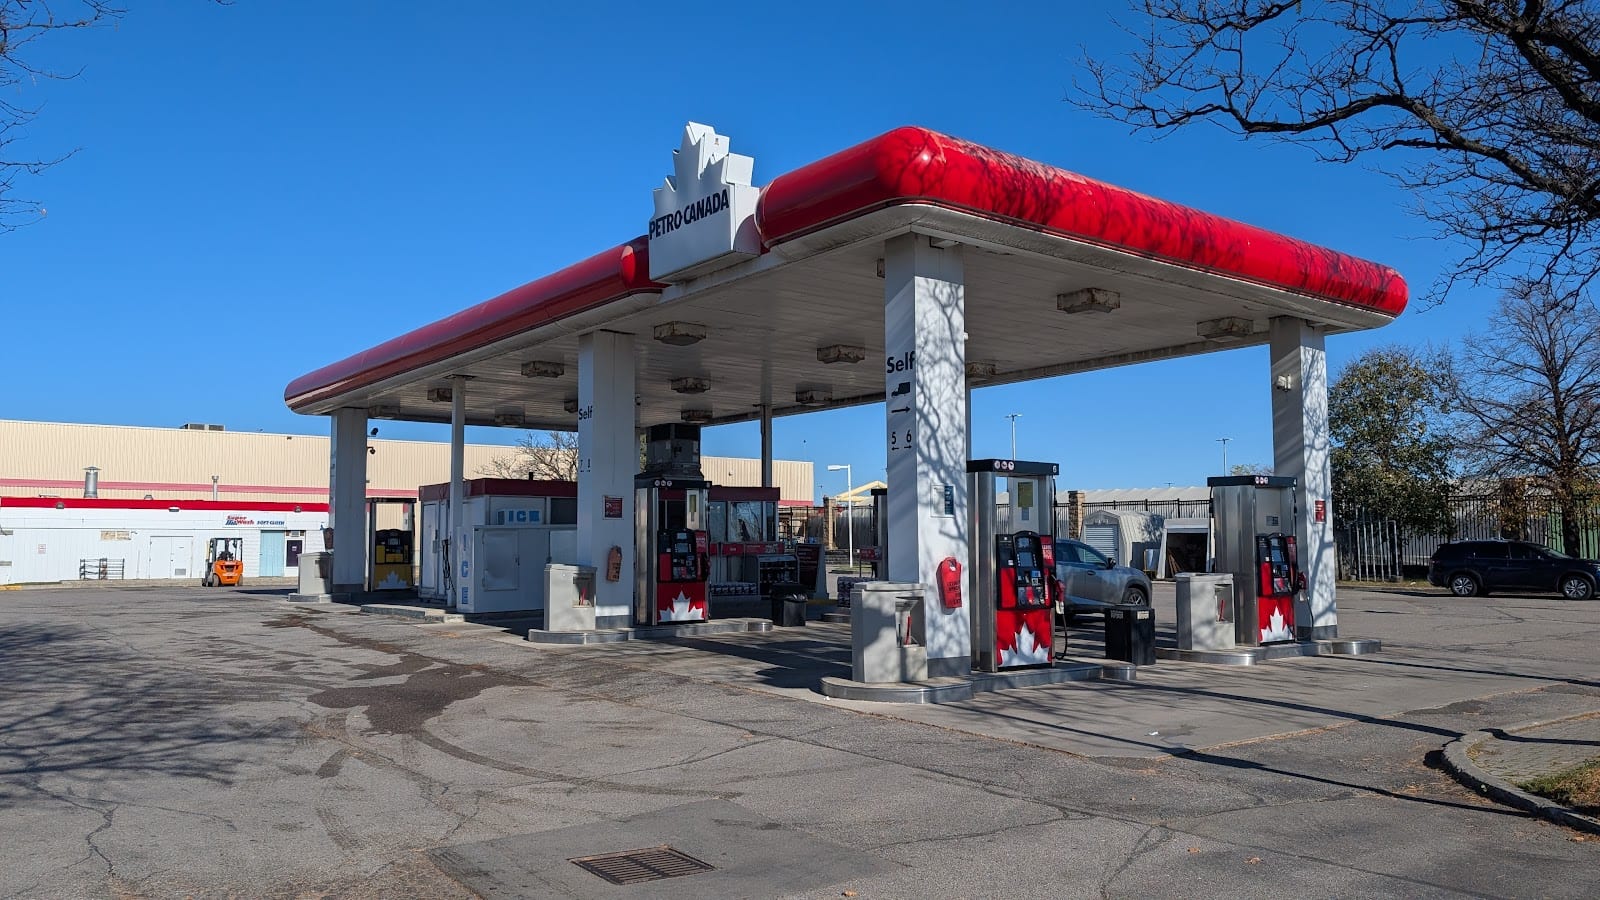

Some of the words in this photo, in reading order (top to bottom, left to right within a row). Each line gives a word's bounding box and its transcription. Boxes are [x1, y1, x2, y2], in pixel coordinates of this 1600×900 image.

[887, 351, 915, 373] Self
[578, 405, 593, 420] Self
[891, 432, 897, 445] 5
[906, 429, 912, 443] 6
